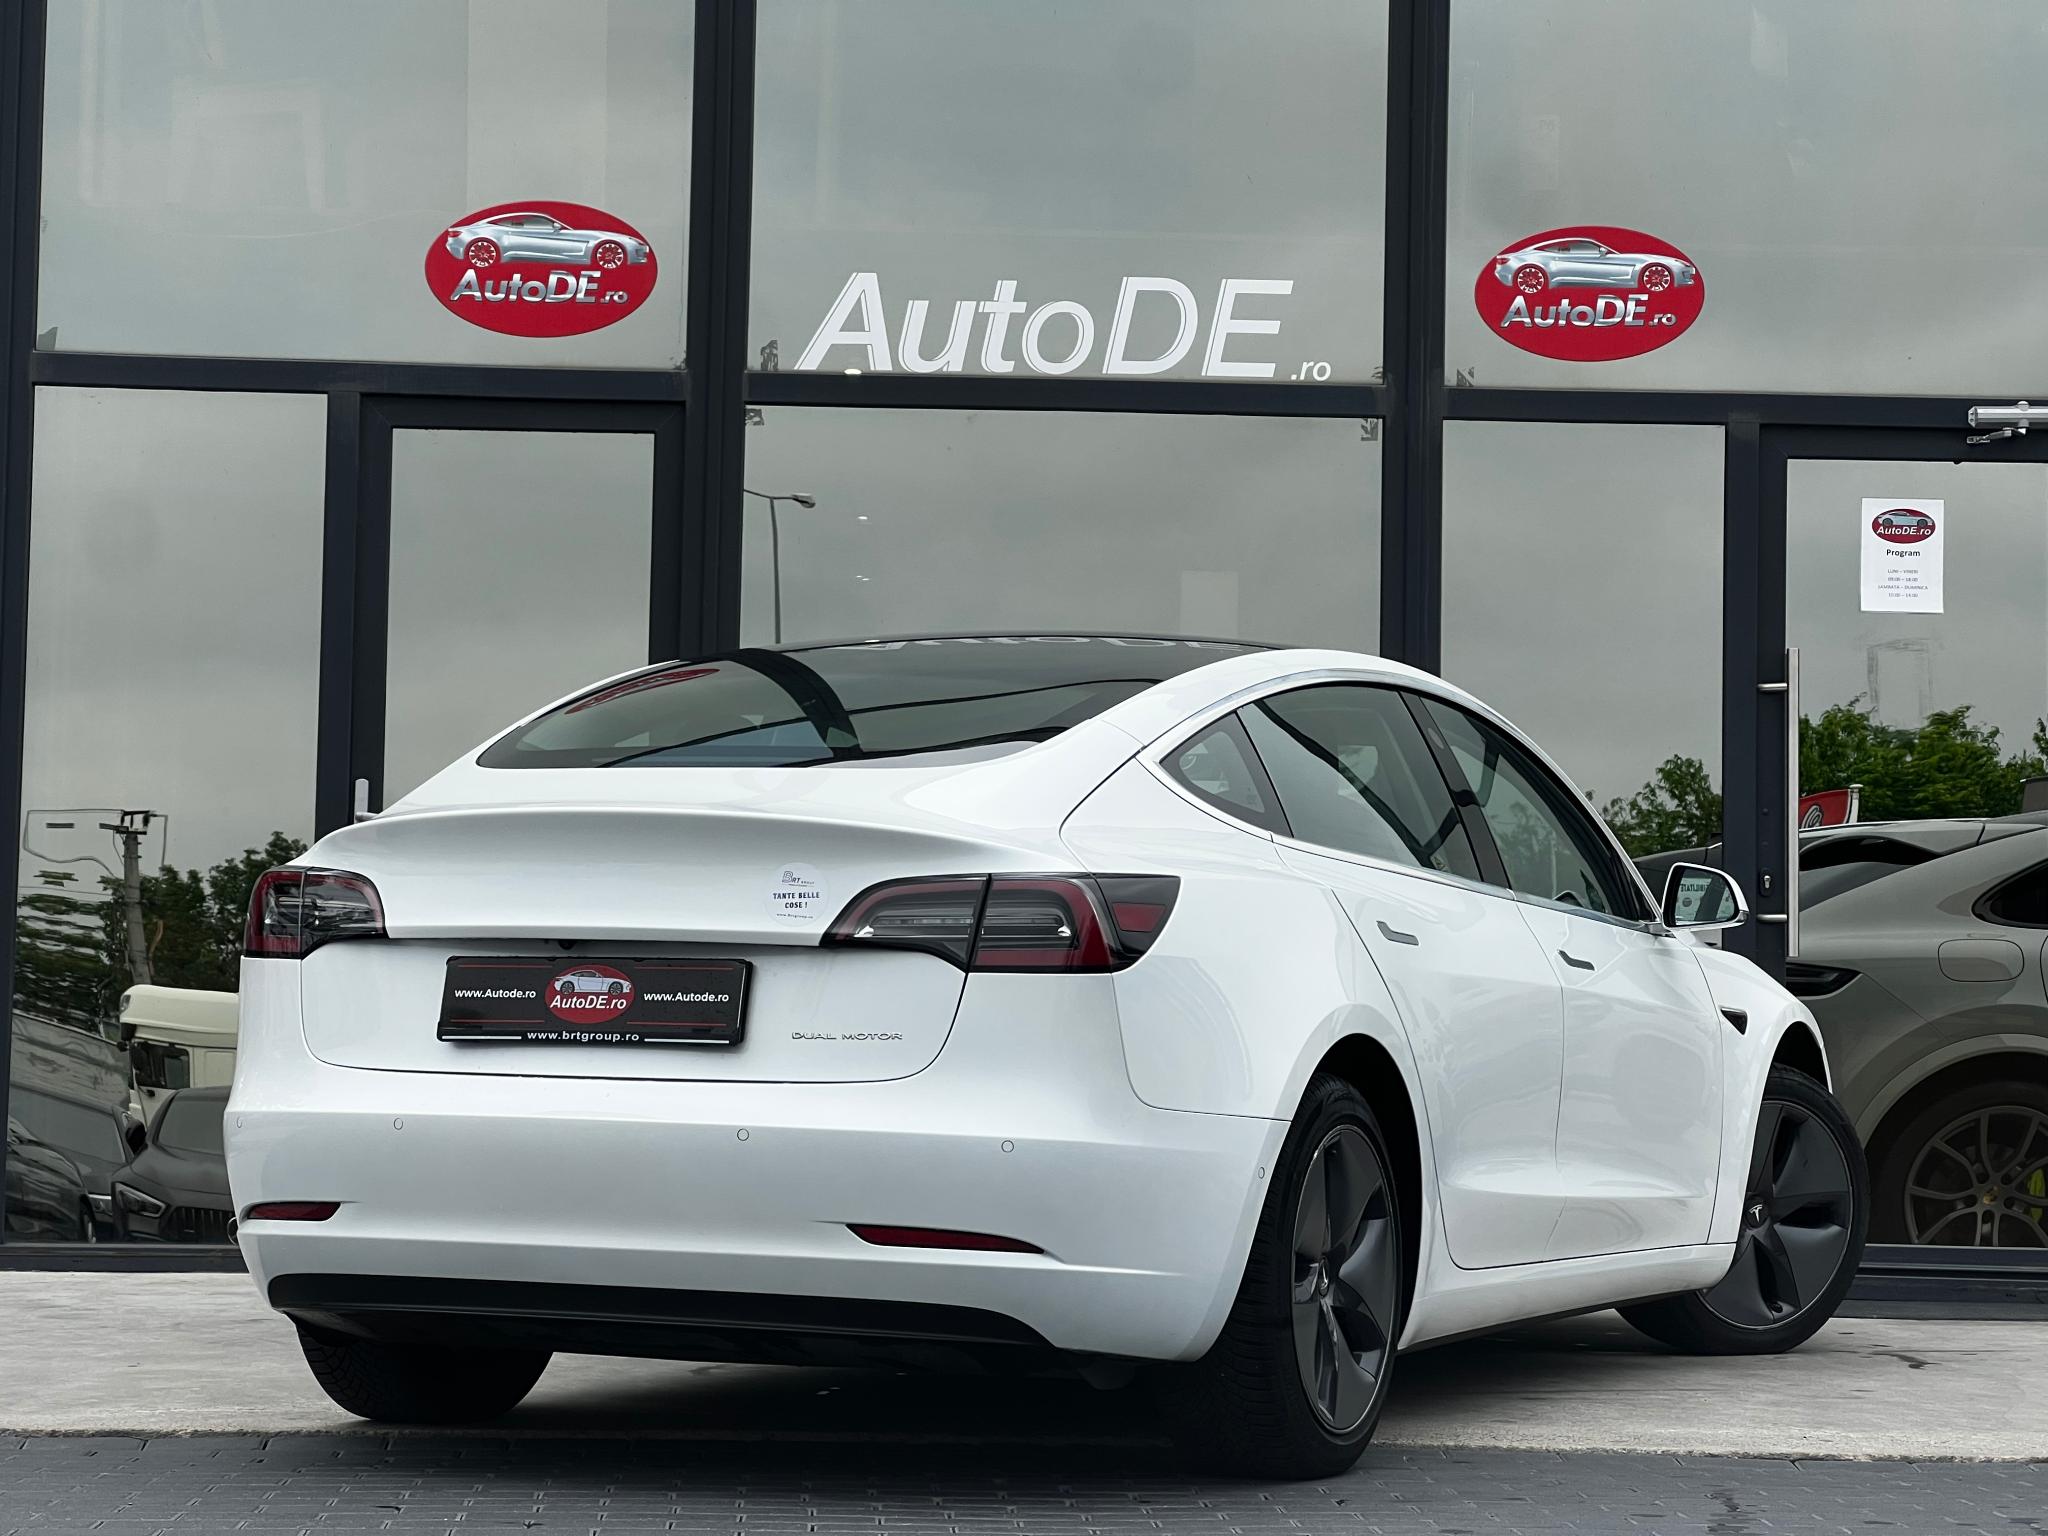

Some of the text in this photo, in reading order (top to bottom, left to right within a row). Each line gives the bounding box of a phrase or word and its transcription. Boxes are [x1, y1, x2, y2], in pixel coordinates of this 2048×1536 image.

[1877, 526, 1932, 536] AutoDE.ro
[1886, 549, 1921, 558] Program
[773, 892, 795, 900] TANTE
[784, 901, 803, 909] COSE
[454, 987, 537, 999] www.Autode.ro
[643, 991, 730, 1003] www.Autode.ro
[549, 994, 628, 1010] AutoDE.ro
[526, 1030, 640, 1043] www.brtgroup.ro
[791, 1031, 903, 1041] DUAL MOTOR
